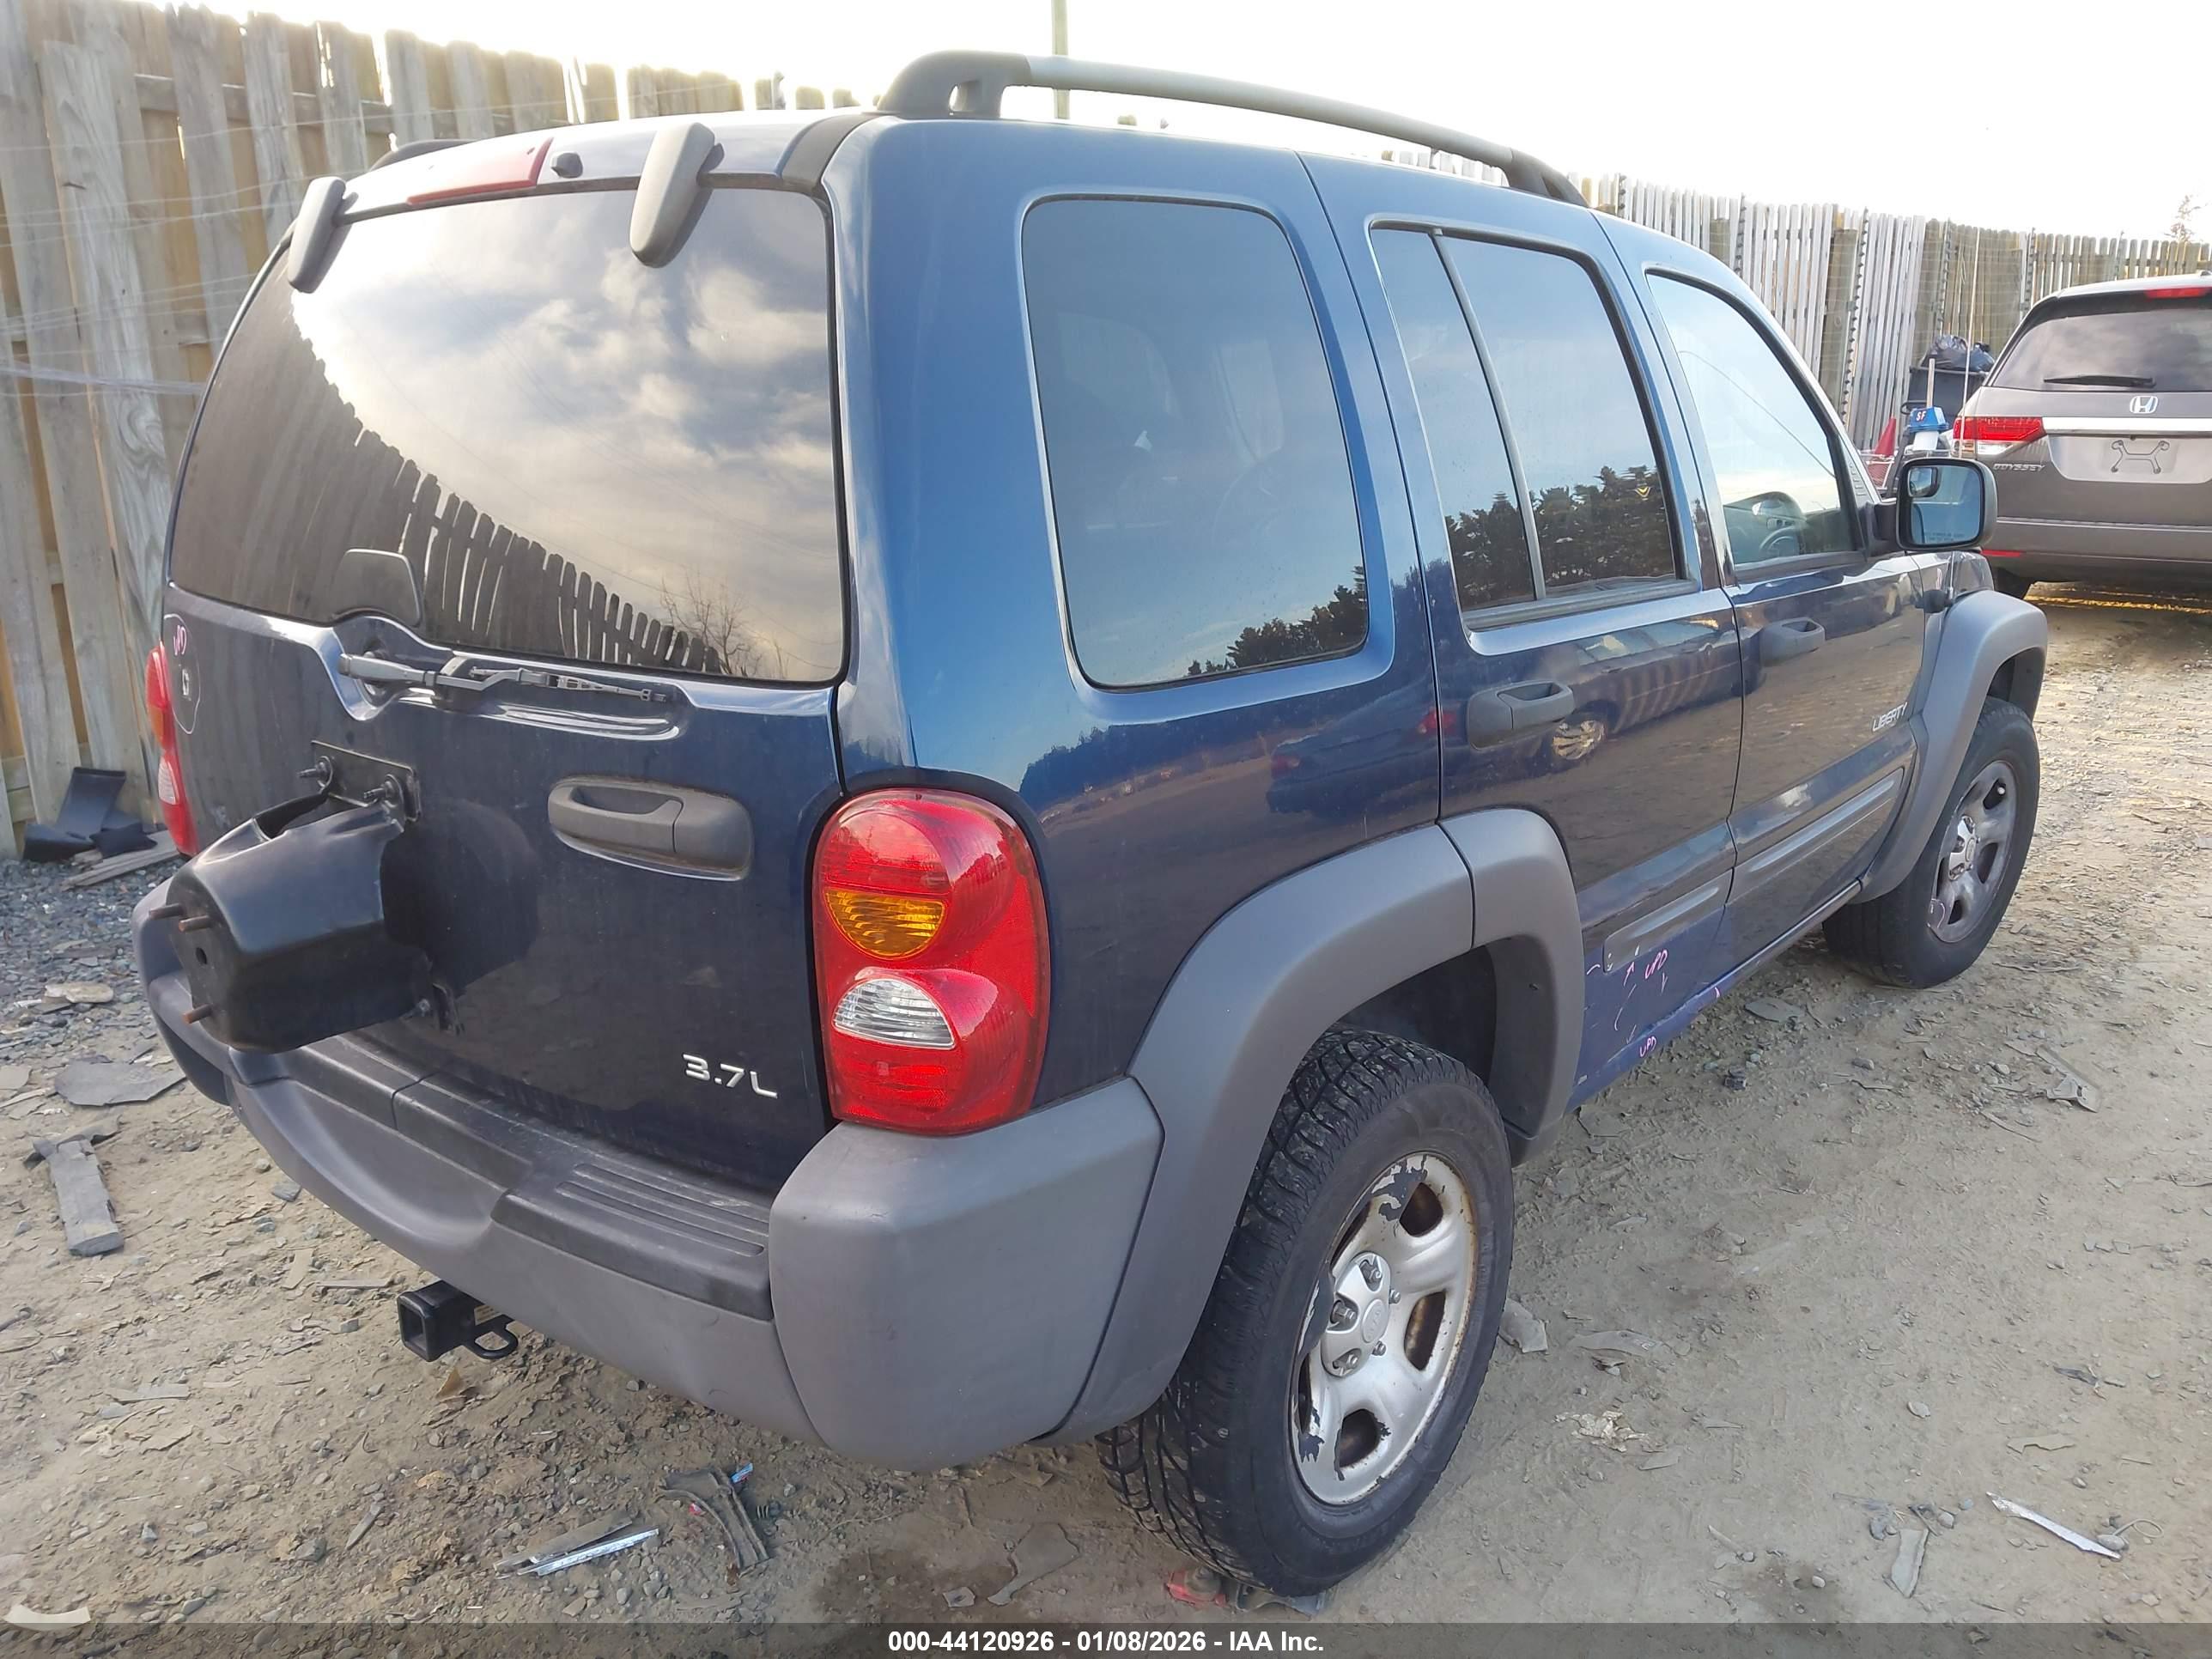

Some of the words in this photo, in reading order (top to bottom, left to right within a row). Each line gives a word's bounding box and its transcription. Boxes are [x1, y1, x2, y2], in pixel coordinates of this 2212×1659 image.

[1916, 410, 1927, 422] SF
[1993, 463, 2046, 472] ODYSSEY
[1873, 701, 1908, 732] LIBERTY
[683, 1054, 778, 1099] 3.7L
